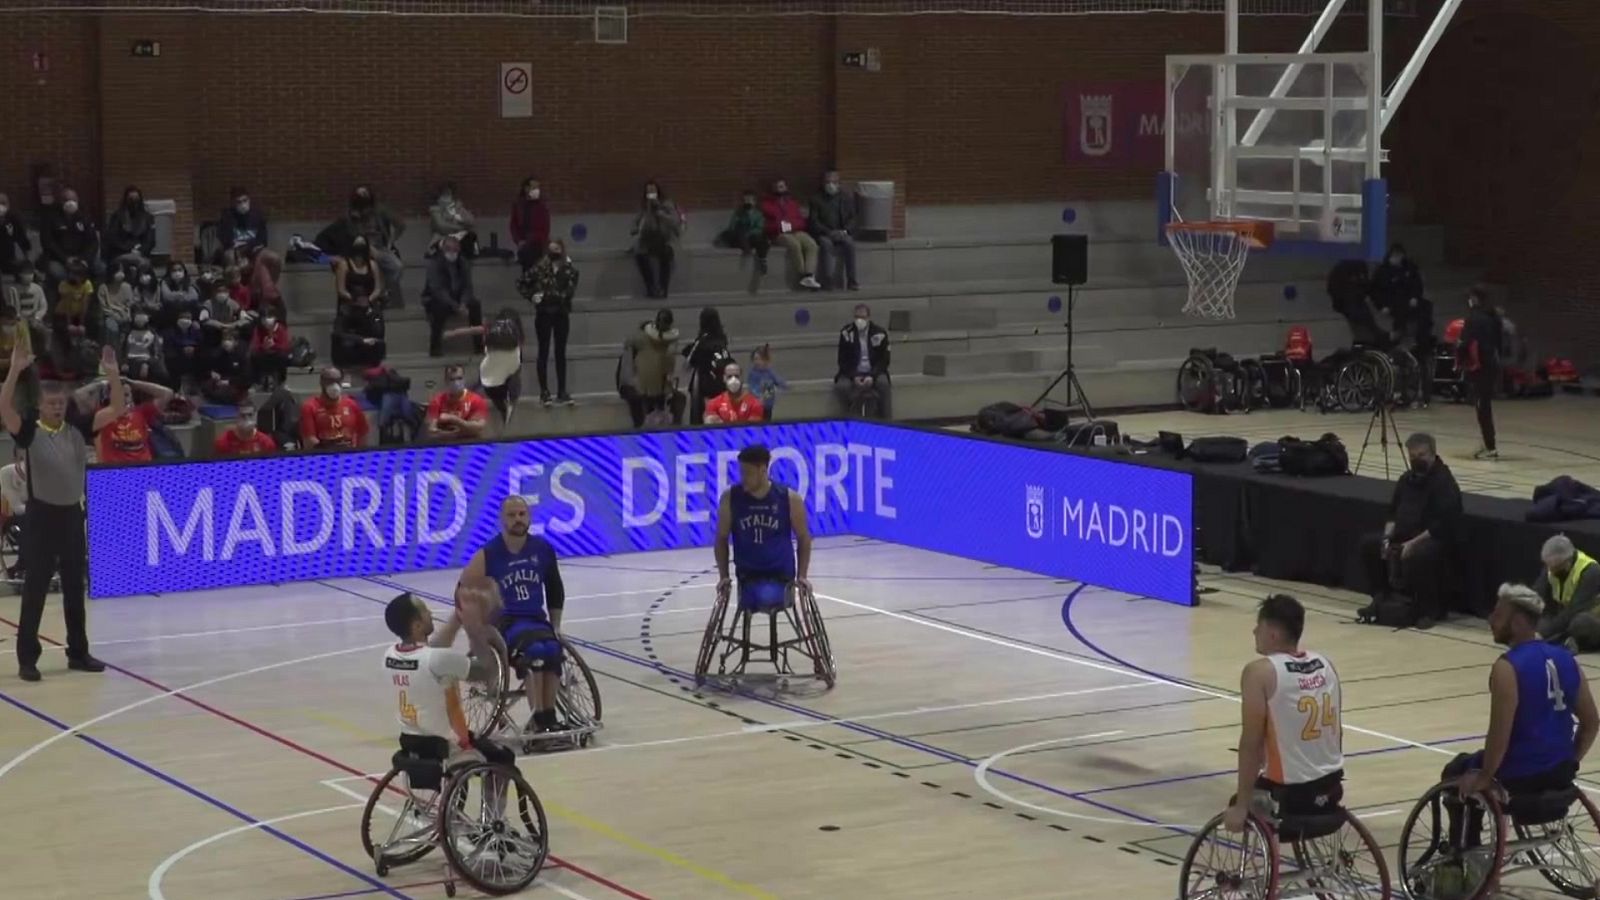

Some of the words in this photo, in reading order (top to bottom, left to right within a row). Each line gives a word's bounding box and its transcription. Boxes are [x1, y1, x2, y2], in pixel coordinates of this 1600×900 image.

[146, 470, 468, 566] MADRID
[740, 514, 779, 531] ITALIA
[753, 528, 763, 544] 11
[1063, 496, 1183, 556] MADRID
[501, 569, 539, 589] ITALIA
[1545, 658, 1567, 711] 4
[399, 690, 417, 724] 4
[1297, 692, 1337, 741] 24
